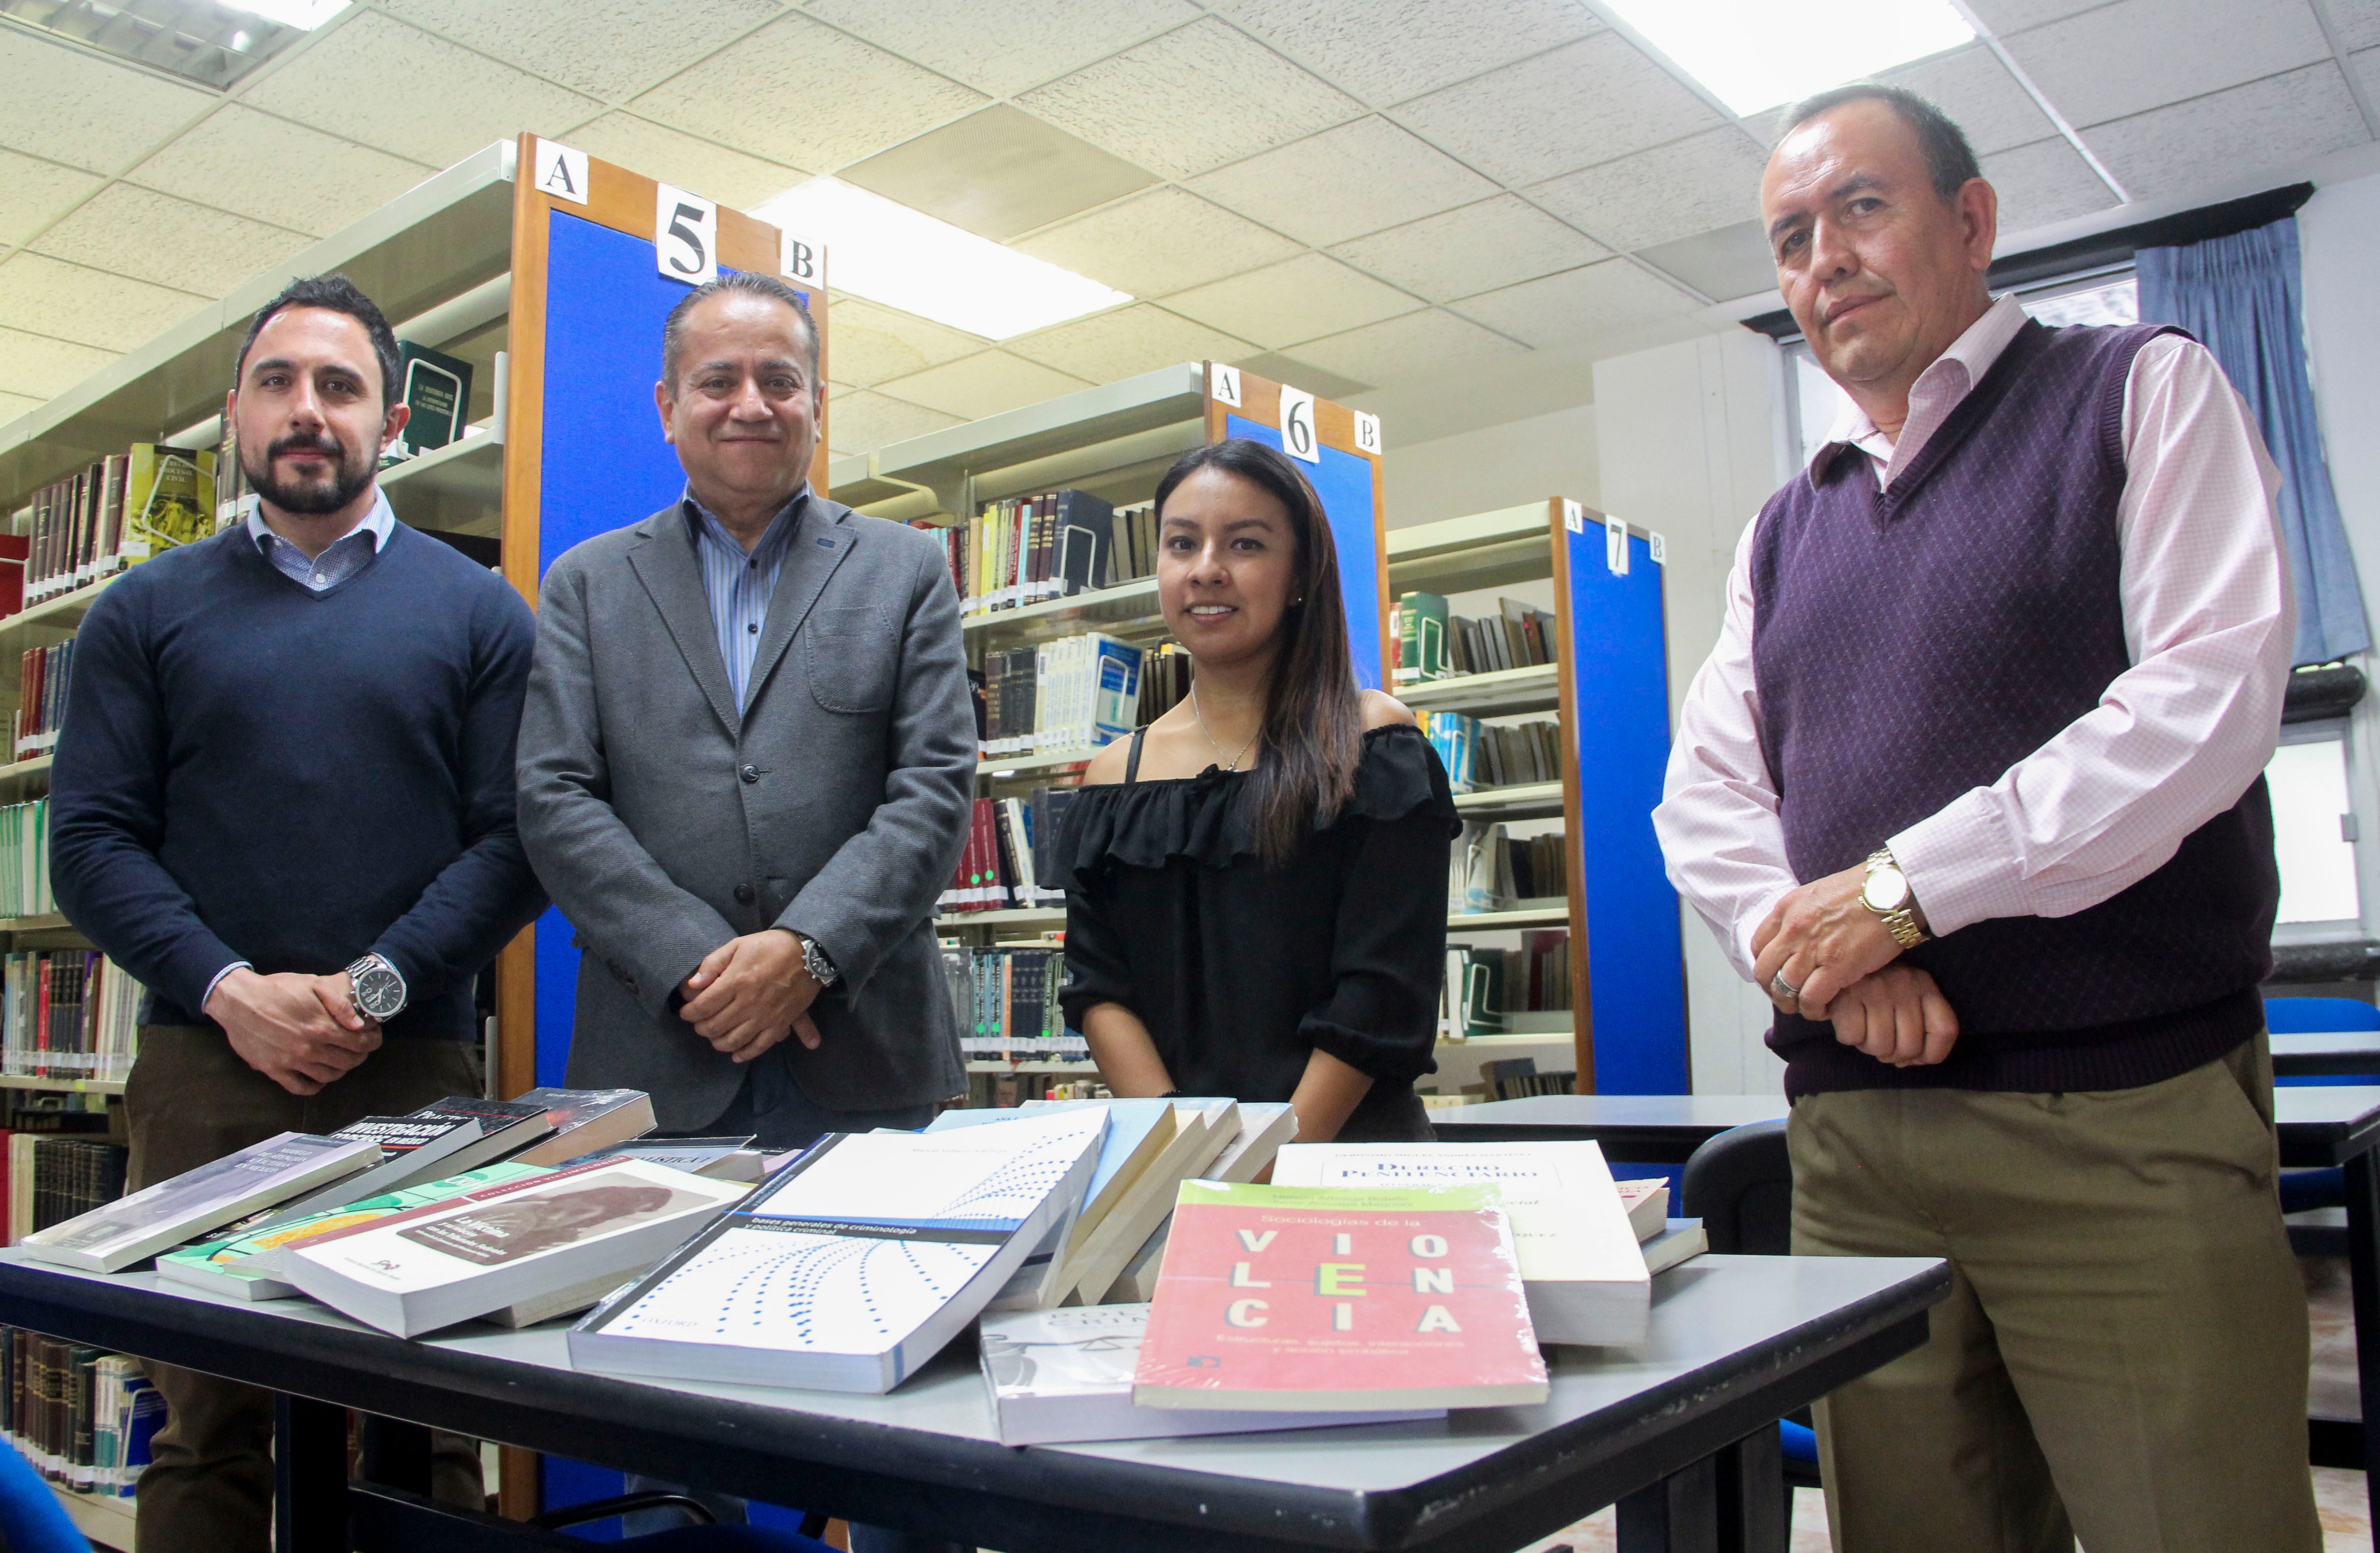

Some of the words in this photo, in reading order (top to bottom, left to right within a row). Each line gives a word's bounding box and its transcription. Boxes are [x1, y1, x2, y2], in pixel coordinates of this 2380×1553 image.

[545, 154, 577, 195] A
[668, 203, 705, 274] 5
[791, 239, 813, 278] B
[1218, 372, 1235, 400] A
[1289, 401, 1310, 454] 6
[1362, 420, 1374, 447] B
[1568, 506, 1578, 529] A
[1610, 524, 1623, 567] 7
[1653, 536, 1662, 558] B
[342, 1122, 456, 1137] INVESTIGACIÓN
[455, 1216, 473, 1225] La
[749, 1224, 793, 1232] política
[793, 1226, 837, 1235] criminal
[751, 1217, 781, 1225] bases
[782, 1219, 833, 1229] generales
[848, 1223, 917, 1236] criminología
[1261, 1215, 1369, 1226] Sociologías
[1405, 1218, 1421, 1227] la
[1237, 1229, 1279, 1252] V
[1409, 1234, 1448, 1258] O
[1232, 1262, 1271, 1288] L
[1318, 1263, 1367, 1296] E
[1413, 1267, 1454, 1294] N
[1226, 1298, 1269, 1327] C
[1415, 1305, 1463, 1333] A
